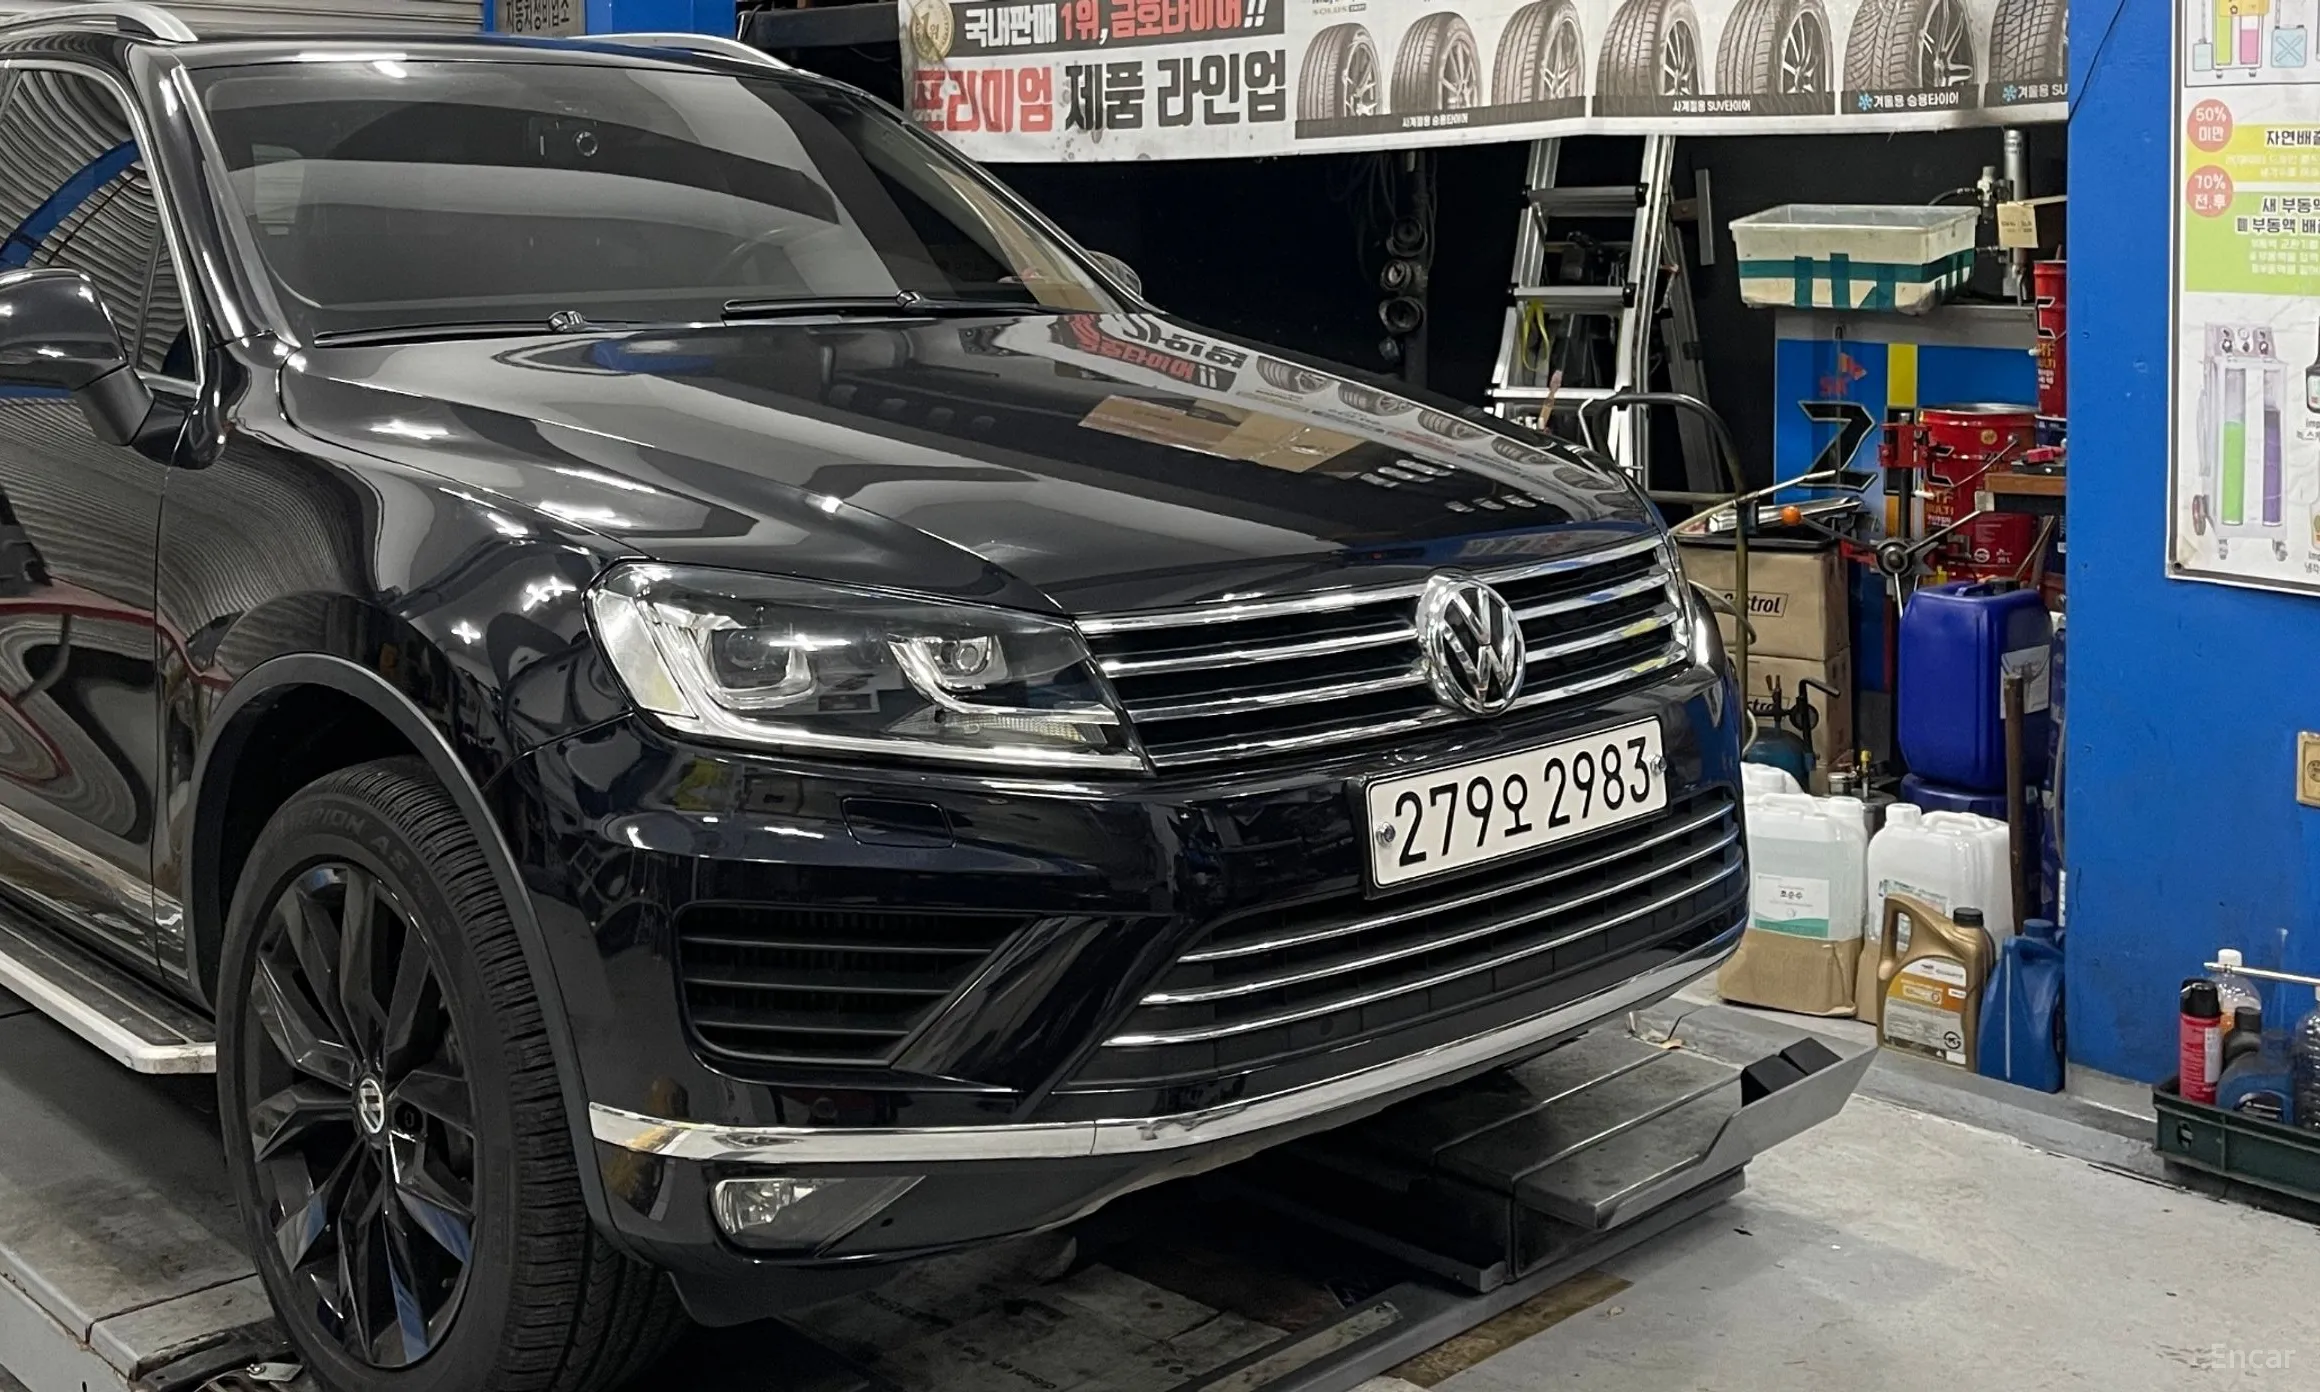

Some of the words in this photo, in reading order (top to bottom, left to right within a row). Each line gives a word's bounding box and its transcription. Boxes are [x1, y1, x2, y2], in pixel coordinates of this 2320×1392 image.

[964, 3, 1057, 48] 국내판매
[913, 65, 1053, 134] 프리미엄
[1064, 60, 1146, 132] 제품
[1157, 49, 1287, 128] 라인업
[1906, 91, 1960, 108] 승용타이어
[1706, 99, 1751, 112] SUV타이어
[2195, 106, 2227, 122] 50%
[2198, 126, 2225, 142] 미만
[2194, 174, 2226, 191] 70%
[2252, 217, 2296, 234] 부동액
[2302, 218, 2320, 234] 배
